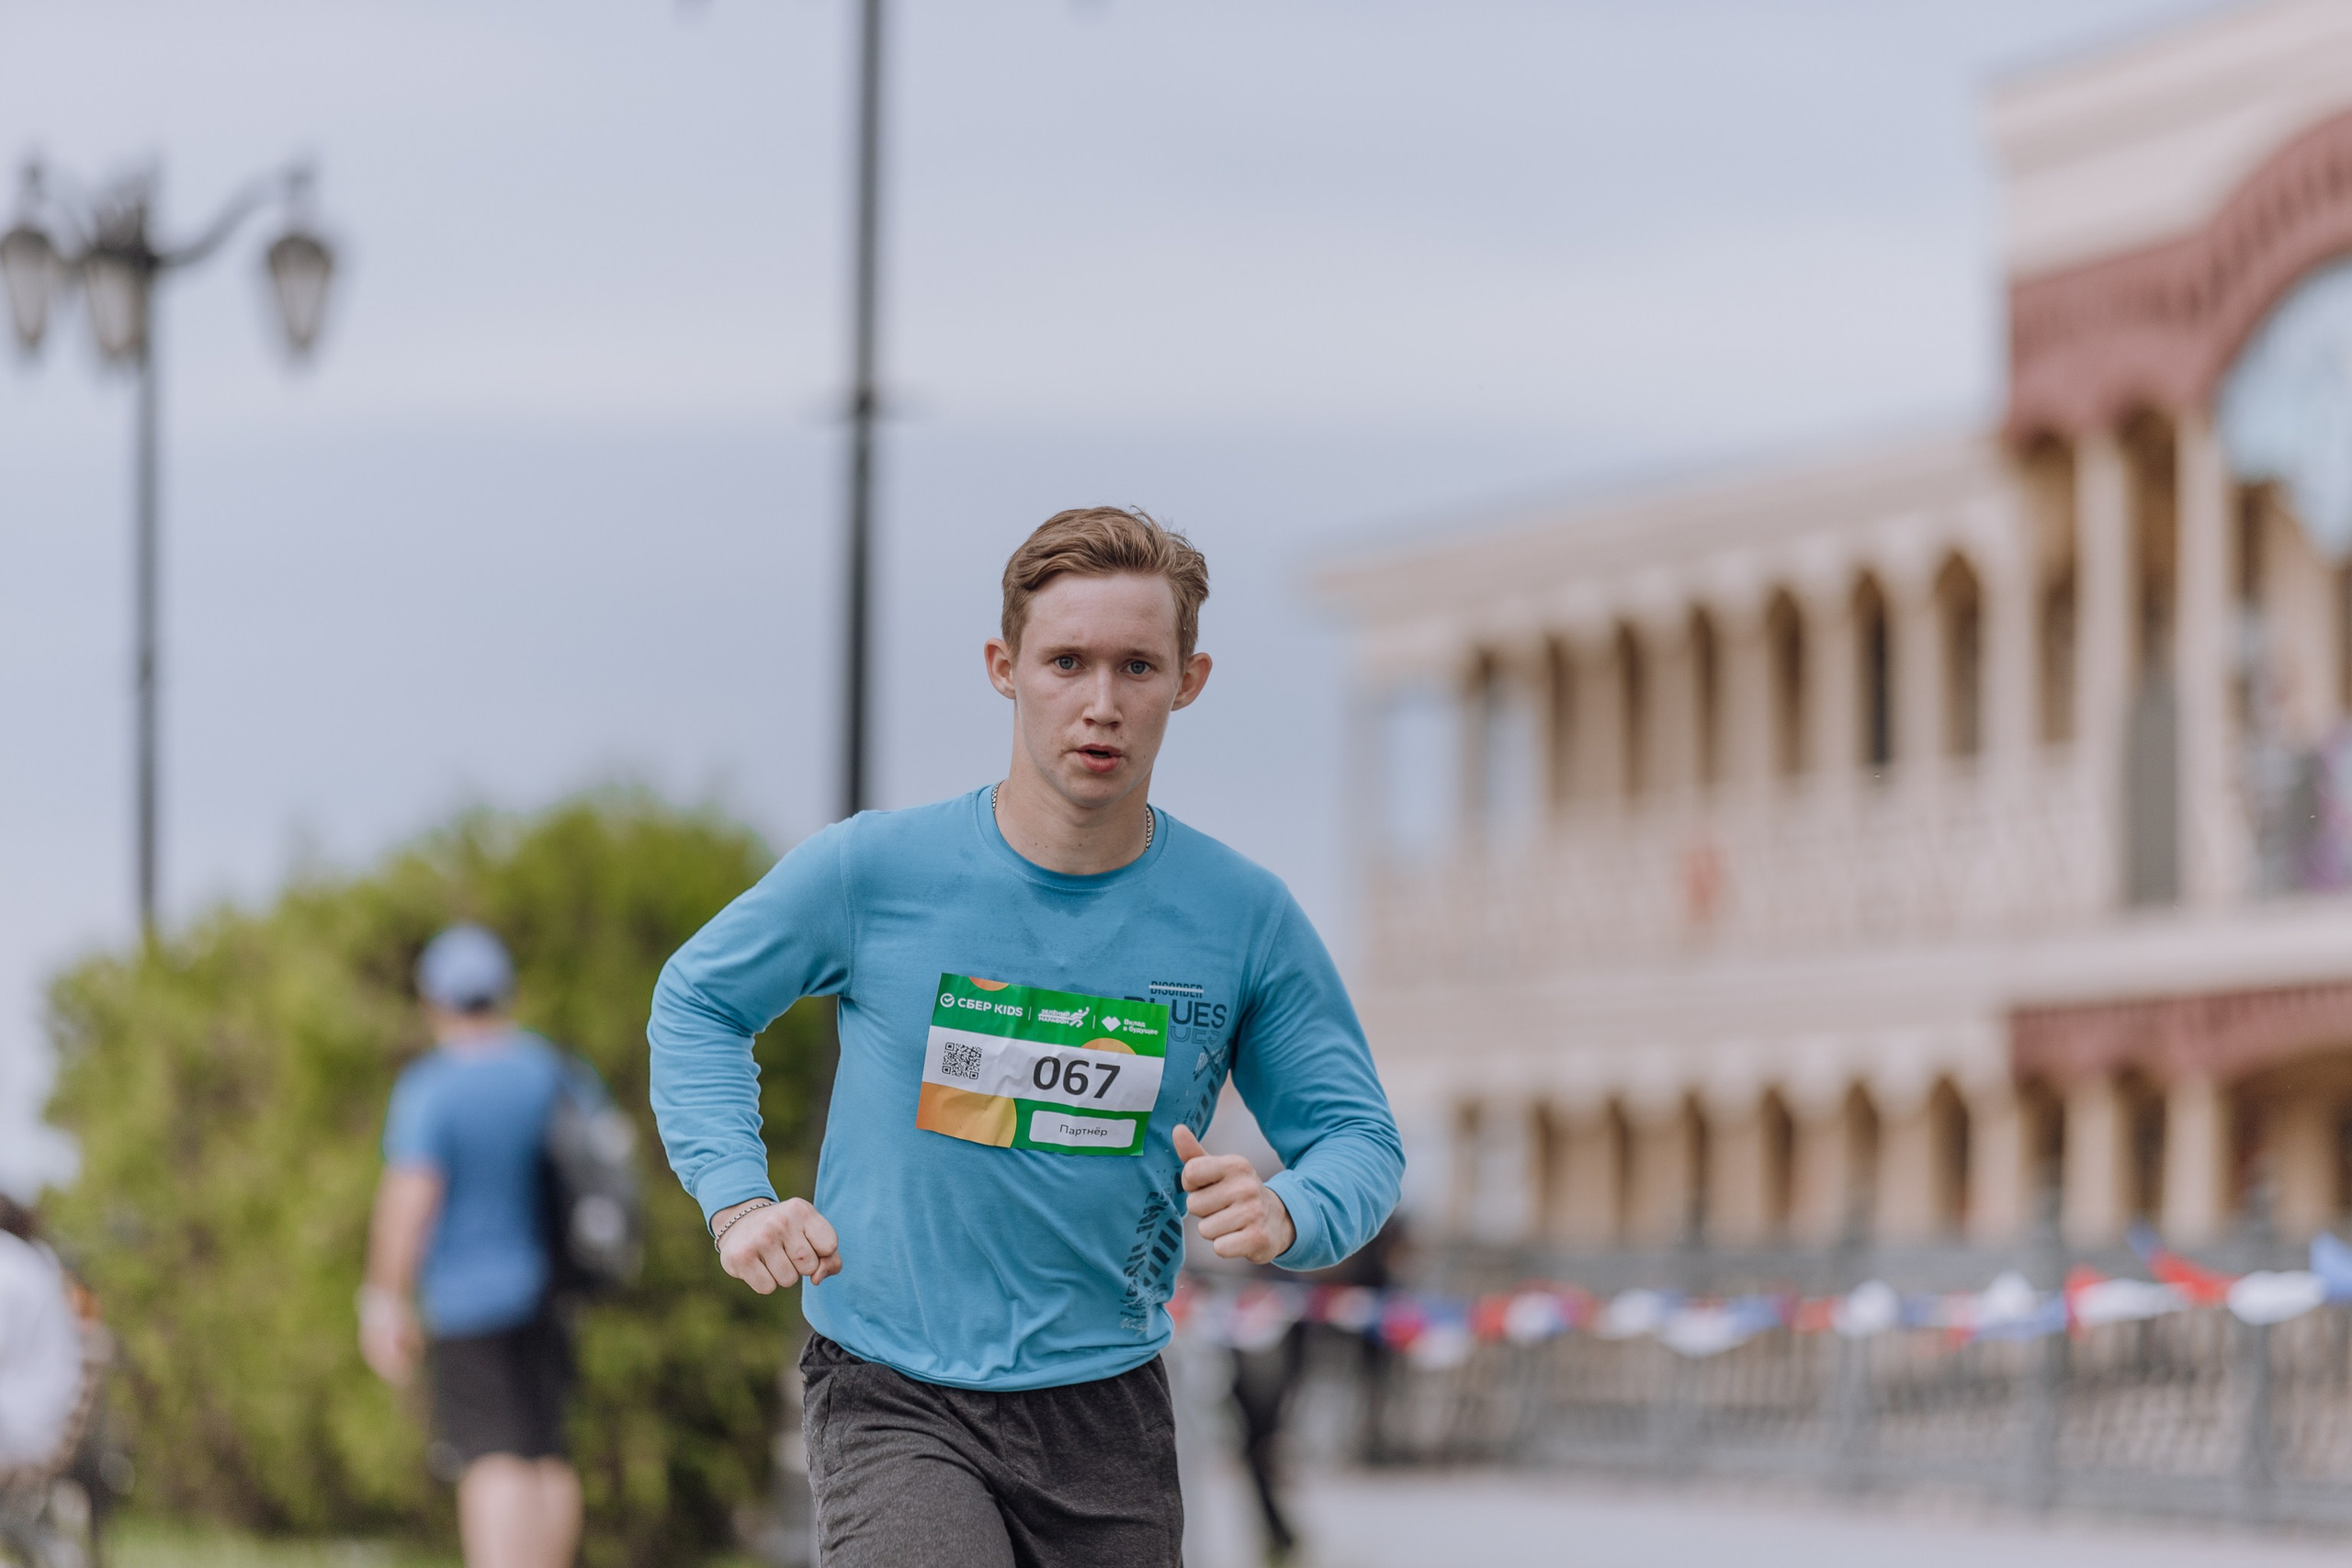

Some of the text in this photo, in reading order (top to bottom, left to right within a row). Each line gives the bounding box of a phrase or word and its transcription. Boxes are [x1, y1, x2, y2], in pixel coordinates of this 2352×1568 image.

[1150, 980, 1203, 998] DISORDER
[957, 998, 1023, 1017] СБЕР KIDS
[1125, 997, 1227, 1029] UES
[1124, 1019, 1146, 1028] Вклад
[1128, 1026, 1159, 1035] будущее
[1033, 1055, 1121, 1099] 067
[1059, 1123, 1108, 1137] Партнёр
